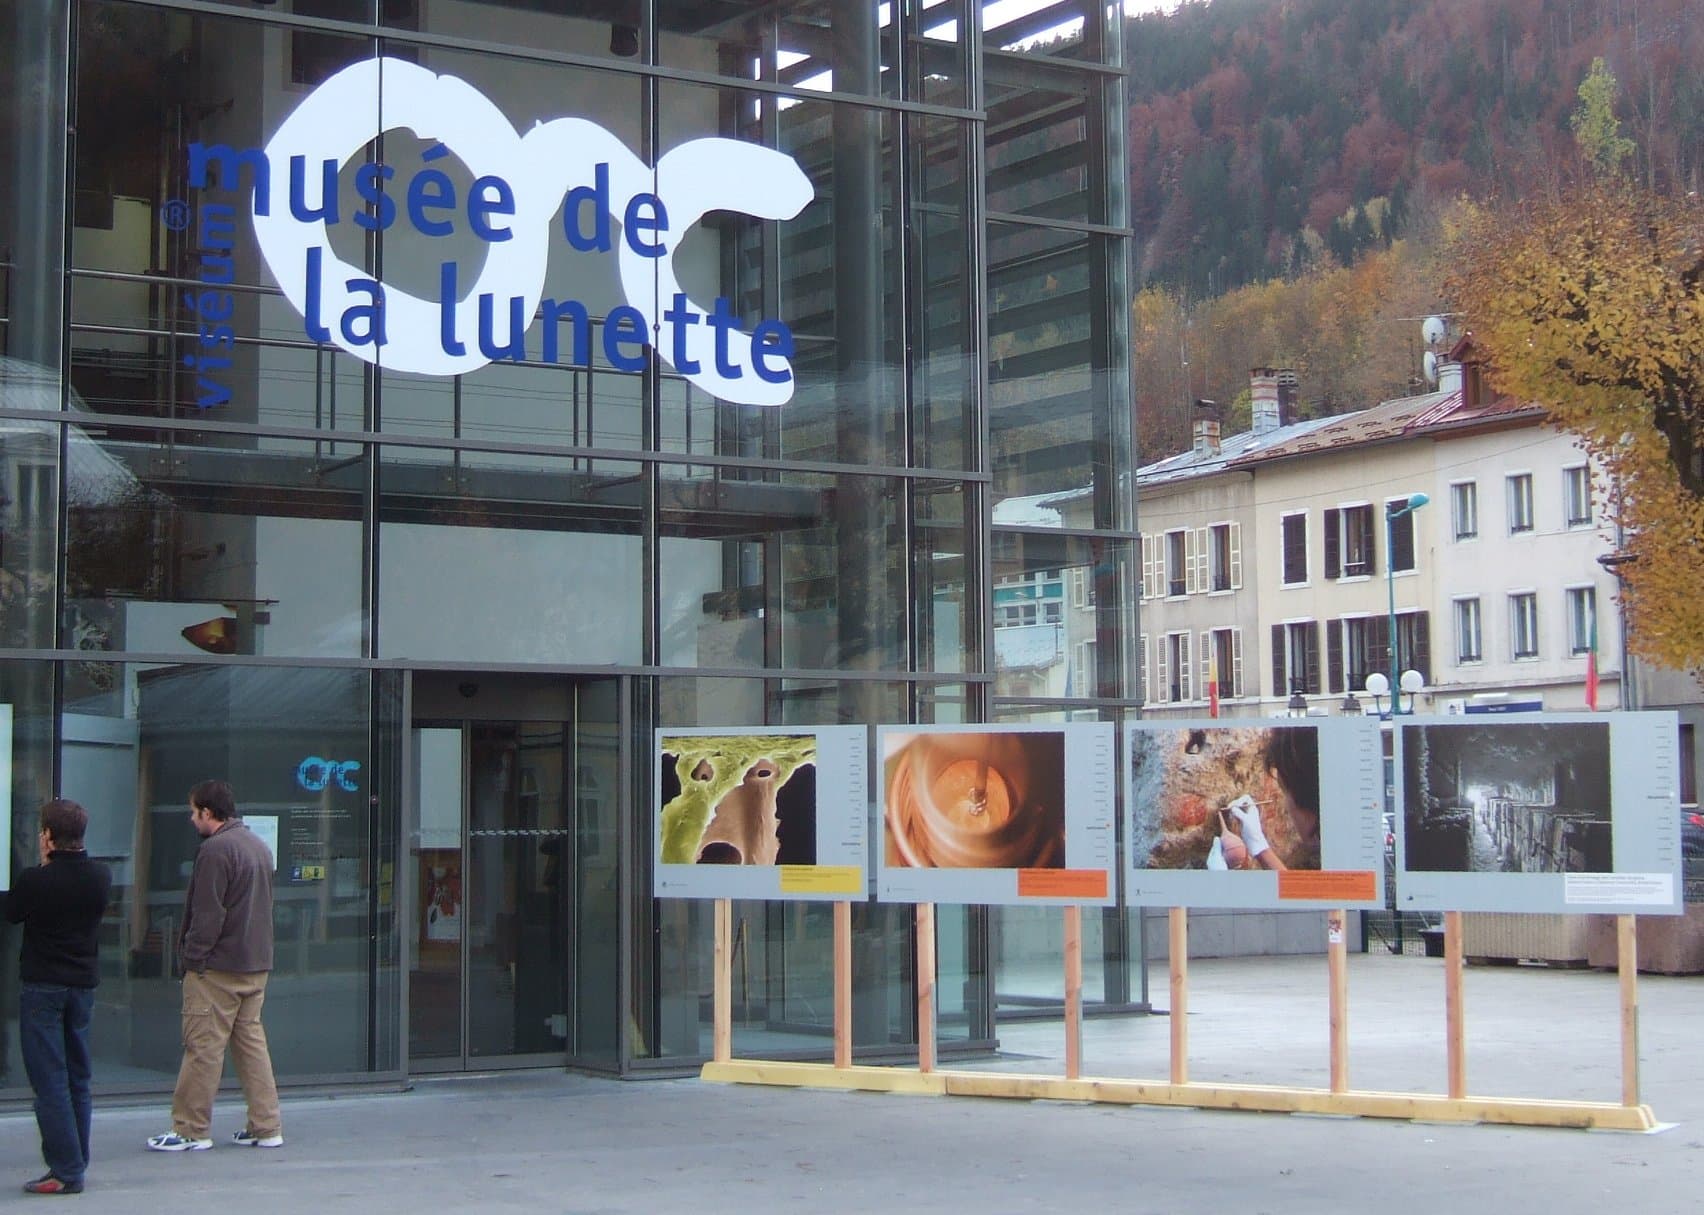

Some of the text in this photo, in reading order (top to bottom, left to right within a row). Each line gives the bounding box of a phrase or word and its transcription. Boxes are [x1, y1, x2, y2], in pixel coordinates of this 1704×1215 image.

[187, 141, 669, 258] musée de
[183, 203, 236, 410] viséum
[304, 246, 796, 385] la lunette
